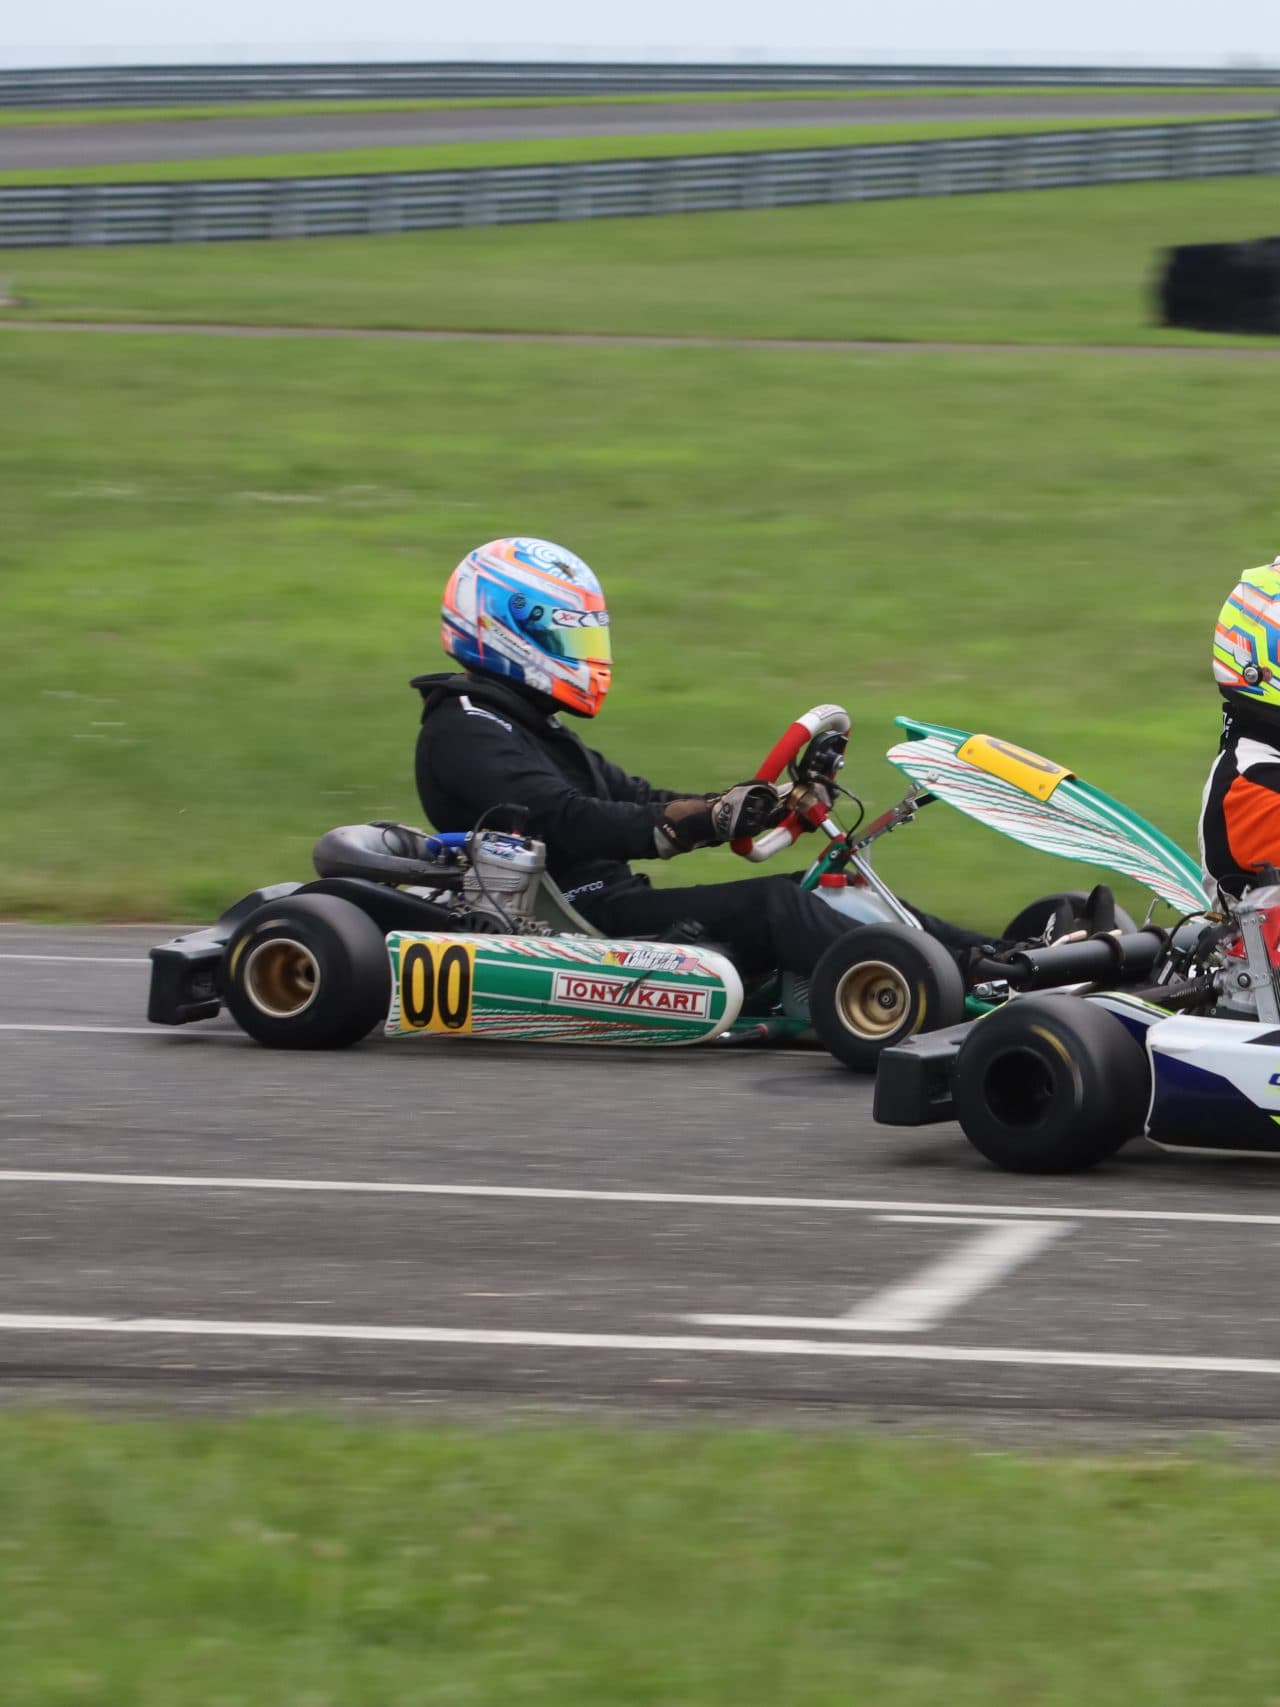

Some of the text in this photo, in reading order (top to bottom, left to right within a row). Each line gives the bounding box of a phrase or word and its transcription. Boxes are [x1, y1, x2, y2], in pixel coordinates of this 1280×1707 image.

[402, 943, 471, 1029] 00
[560, 976, 706, 1011] TONY KART
